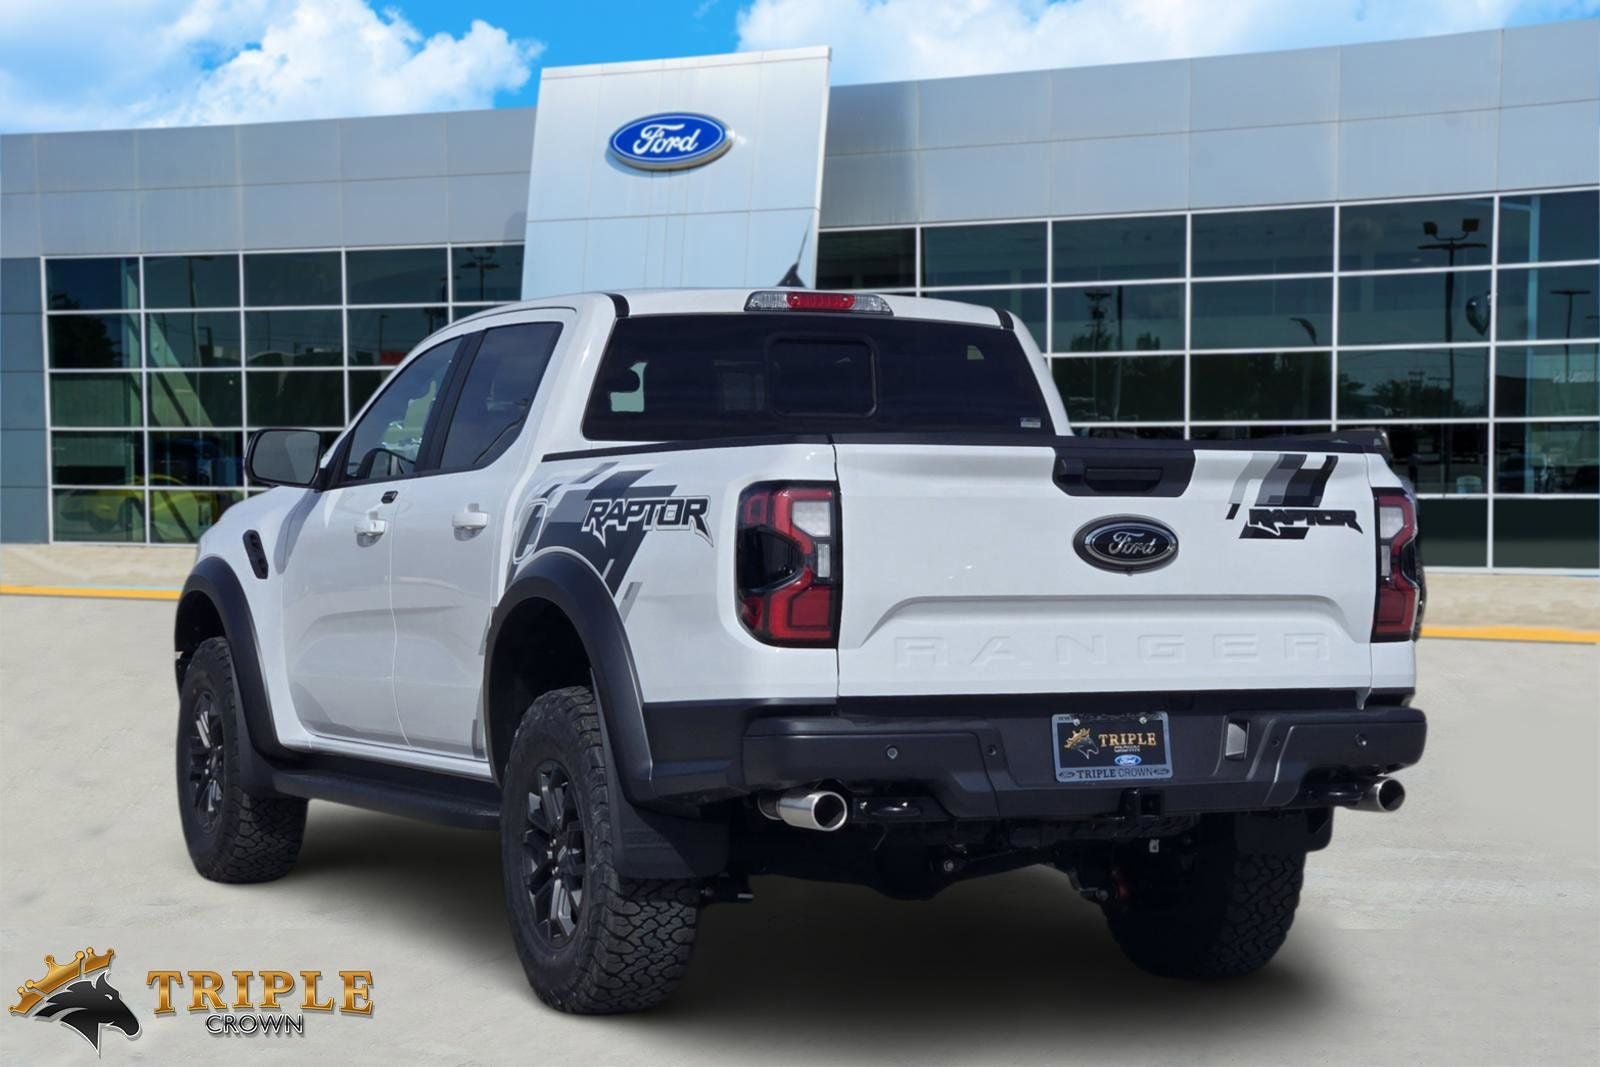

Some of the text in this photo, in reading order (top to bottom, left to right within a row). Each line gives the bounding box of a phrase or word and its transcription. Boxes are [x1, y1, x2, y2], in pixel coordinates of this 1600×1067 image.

[632, 123, 702, 155] Ford
[581, 496, 714, 548] RAPTOR
[1248, 508, 1364, 534] RAPTOR
[1108, 531, 1157, 554] Ford
[894, 633, 1331, 667] RANGER
[1098, 732, 1157, 747] TRIPLE
[1076, 768, 1117, 779] TRIPLE
[1119, 767, 1154, 778] CROWN
